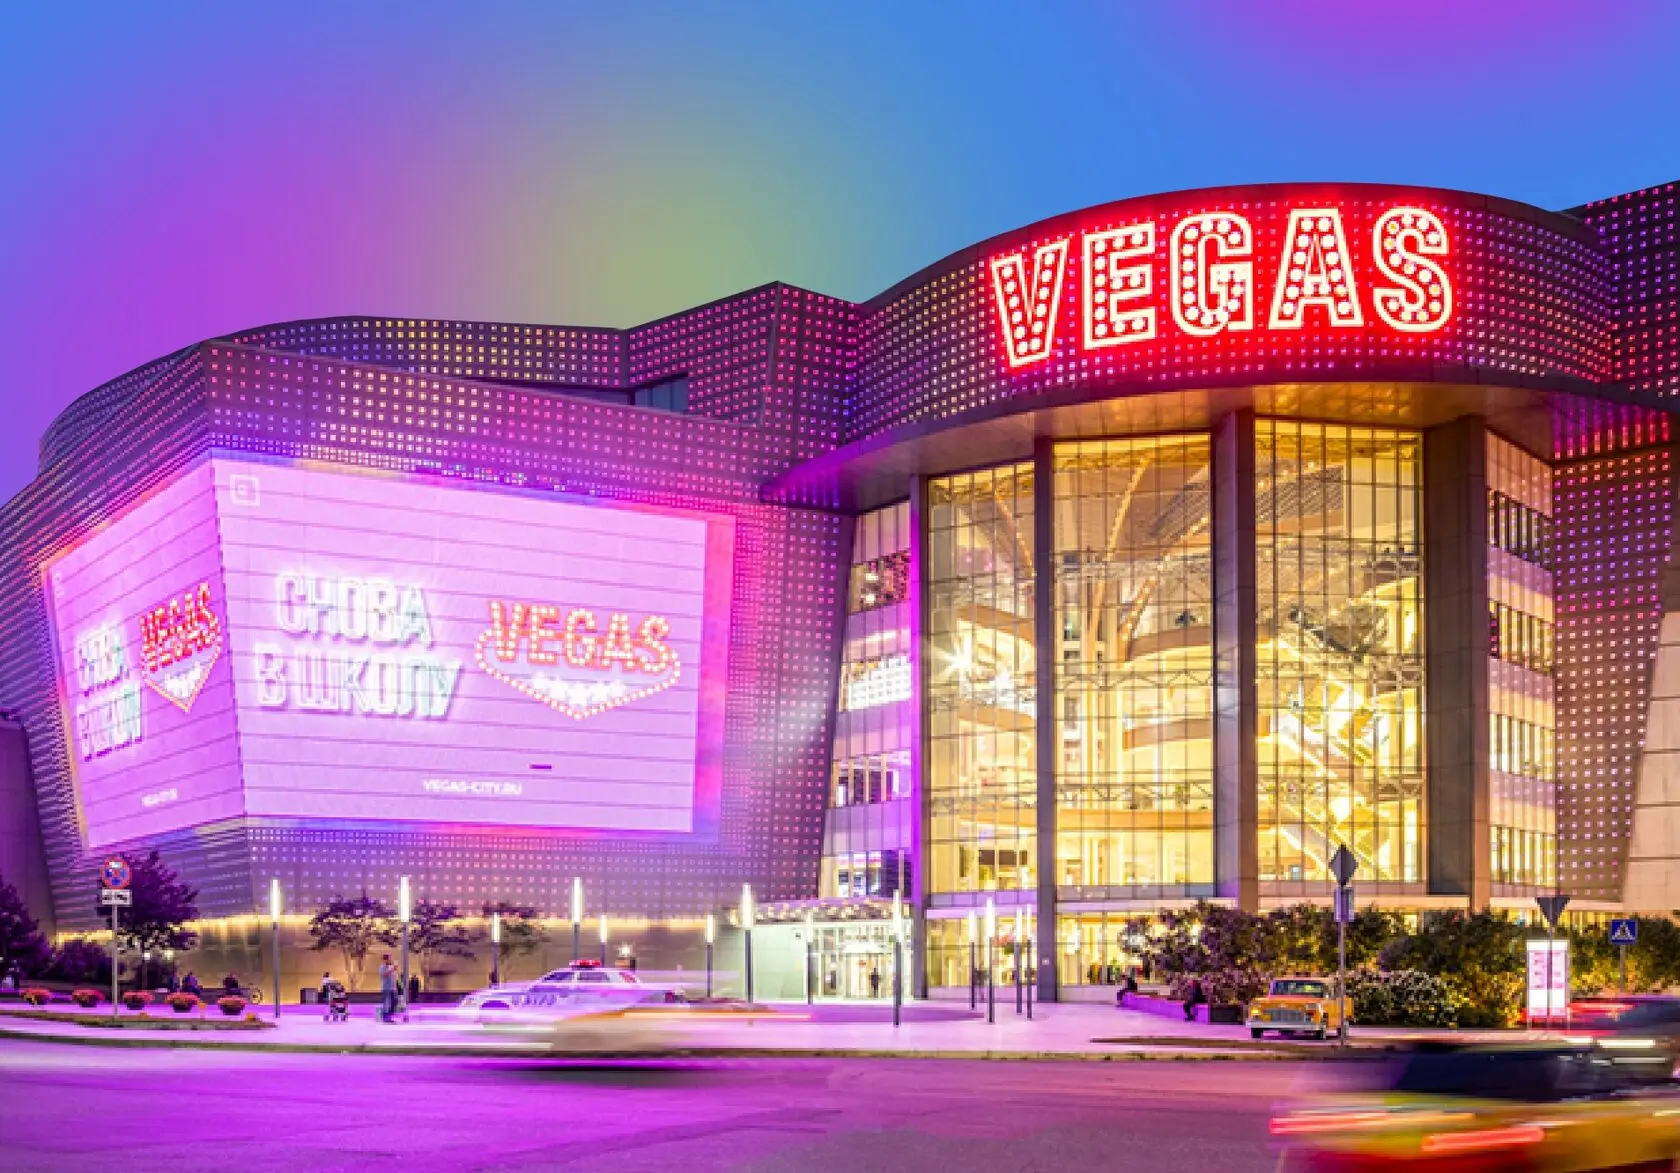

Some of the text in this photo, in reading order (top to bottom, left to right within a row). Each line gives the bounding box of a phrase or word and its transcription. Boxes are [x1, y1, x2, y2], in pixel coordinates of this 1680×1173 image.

[991, 205, 1454, 368] VEGAS
[276, 572, 434, 651] СНОВА
[489, 600, 672, 676] VEGAS
[254, 643, 289, 711] В
[293, 648, 465, 721] ШКОЛУ
